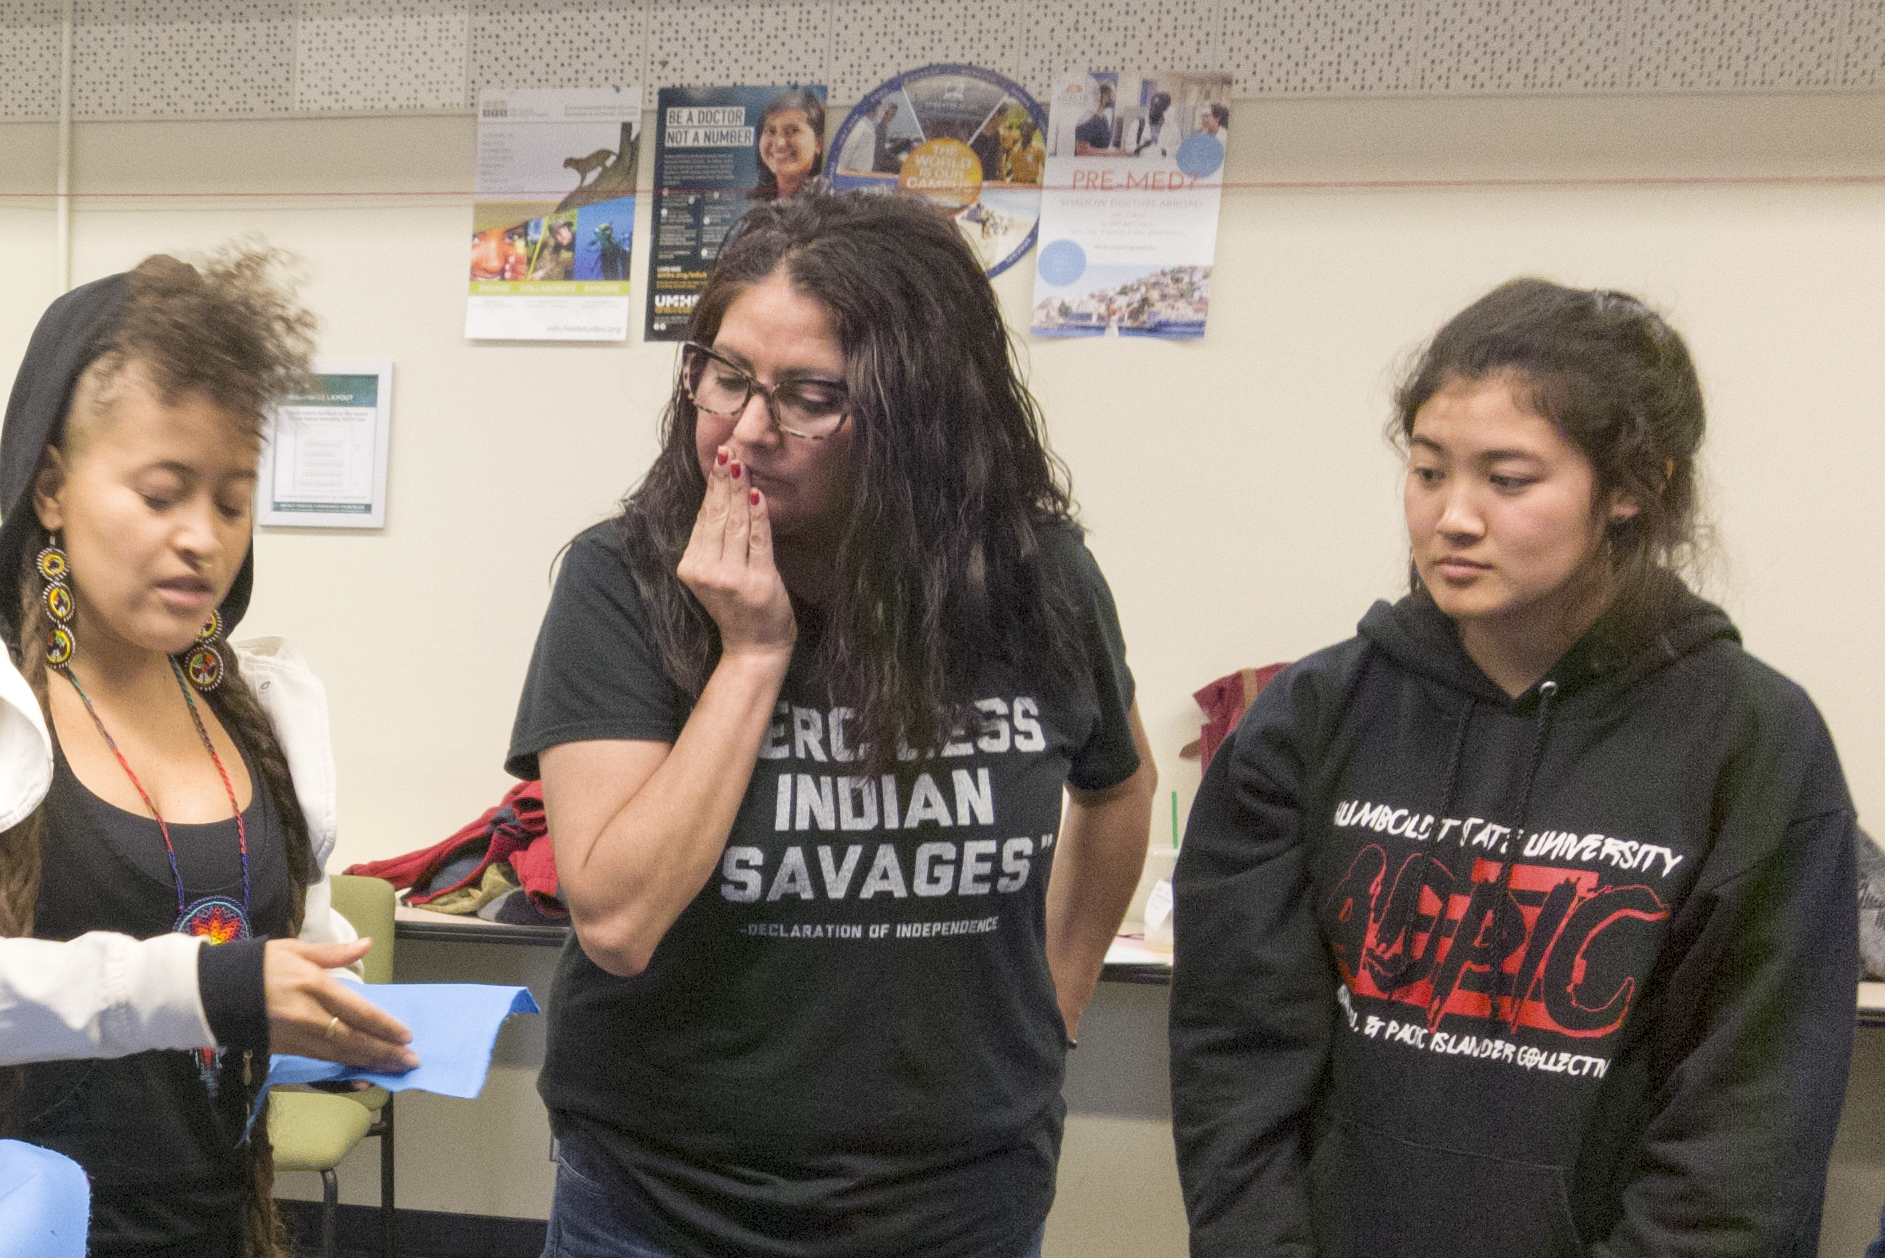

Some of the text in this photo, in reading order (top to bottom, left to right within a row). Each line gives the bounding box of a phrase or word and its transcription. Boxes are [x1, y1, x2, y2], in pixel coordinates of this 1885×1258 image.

[668, 109, 743, 124] BE A DOCTOR
[667, 129, 752, 144] NOT A NUMBER
[915, 155, 972, 169] WORLD
[906, 177, 974, 193] CAMPUS
[774, 768, 994, 832] INDIAN
[1523, 831, 1683, 878] UNIVERSITY
[869, 923, 890, 939] OF
[895, 916, 999, 938] INDEPENDENCE
[1430, 1032, 1516, 1064] ISLANDER
